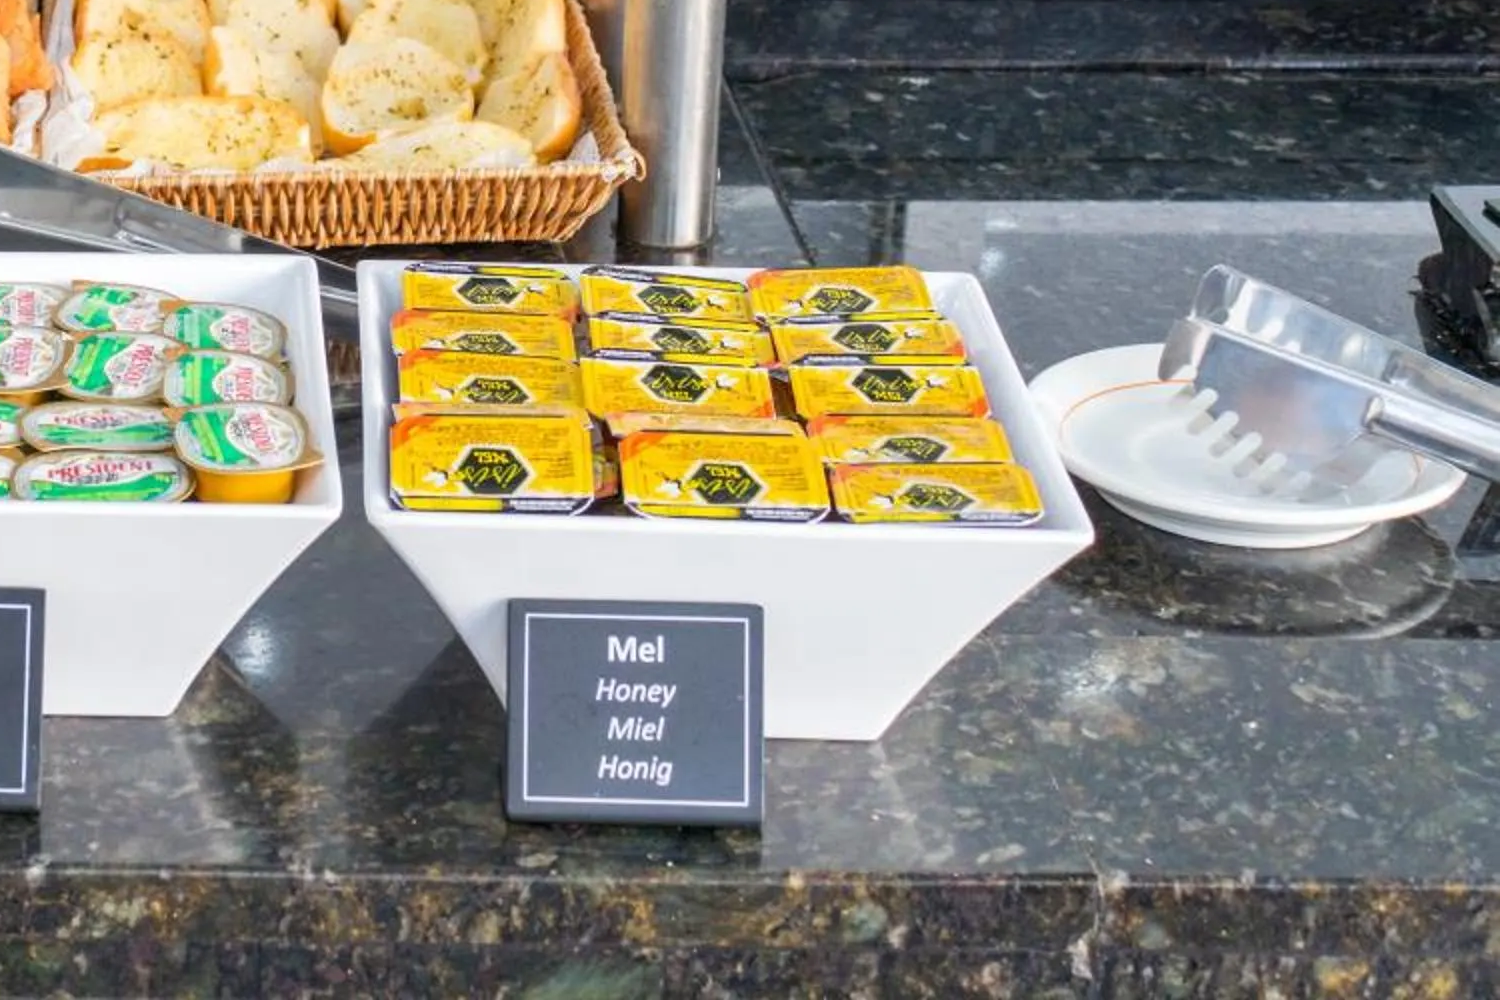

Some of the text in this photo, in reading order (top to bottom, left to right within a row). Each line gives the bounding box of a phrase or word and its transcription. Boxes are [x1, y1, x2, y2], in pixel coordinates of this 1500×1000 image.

[607, 634, 665, 663] Mel
[595, 677, 677, 708] Honey
[607, 716, 666, 741] Miel
[597, 755, 673, 786] Honig
